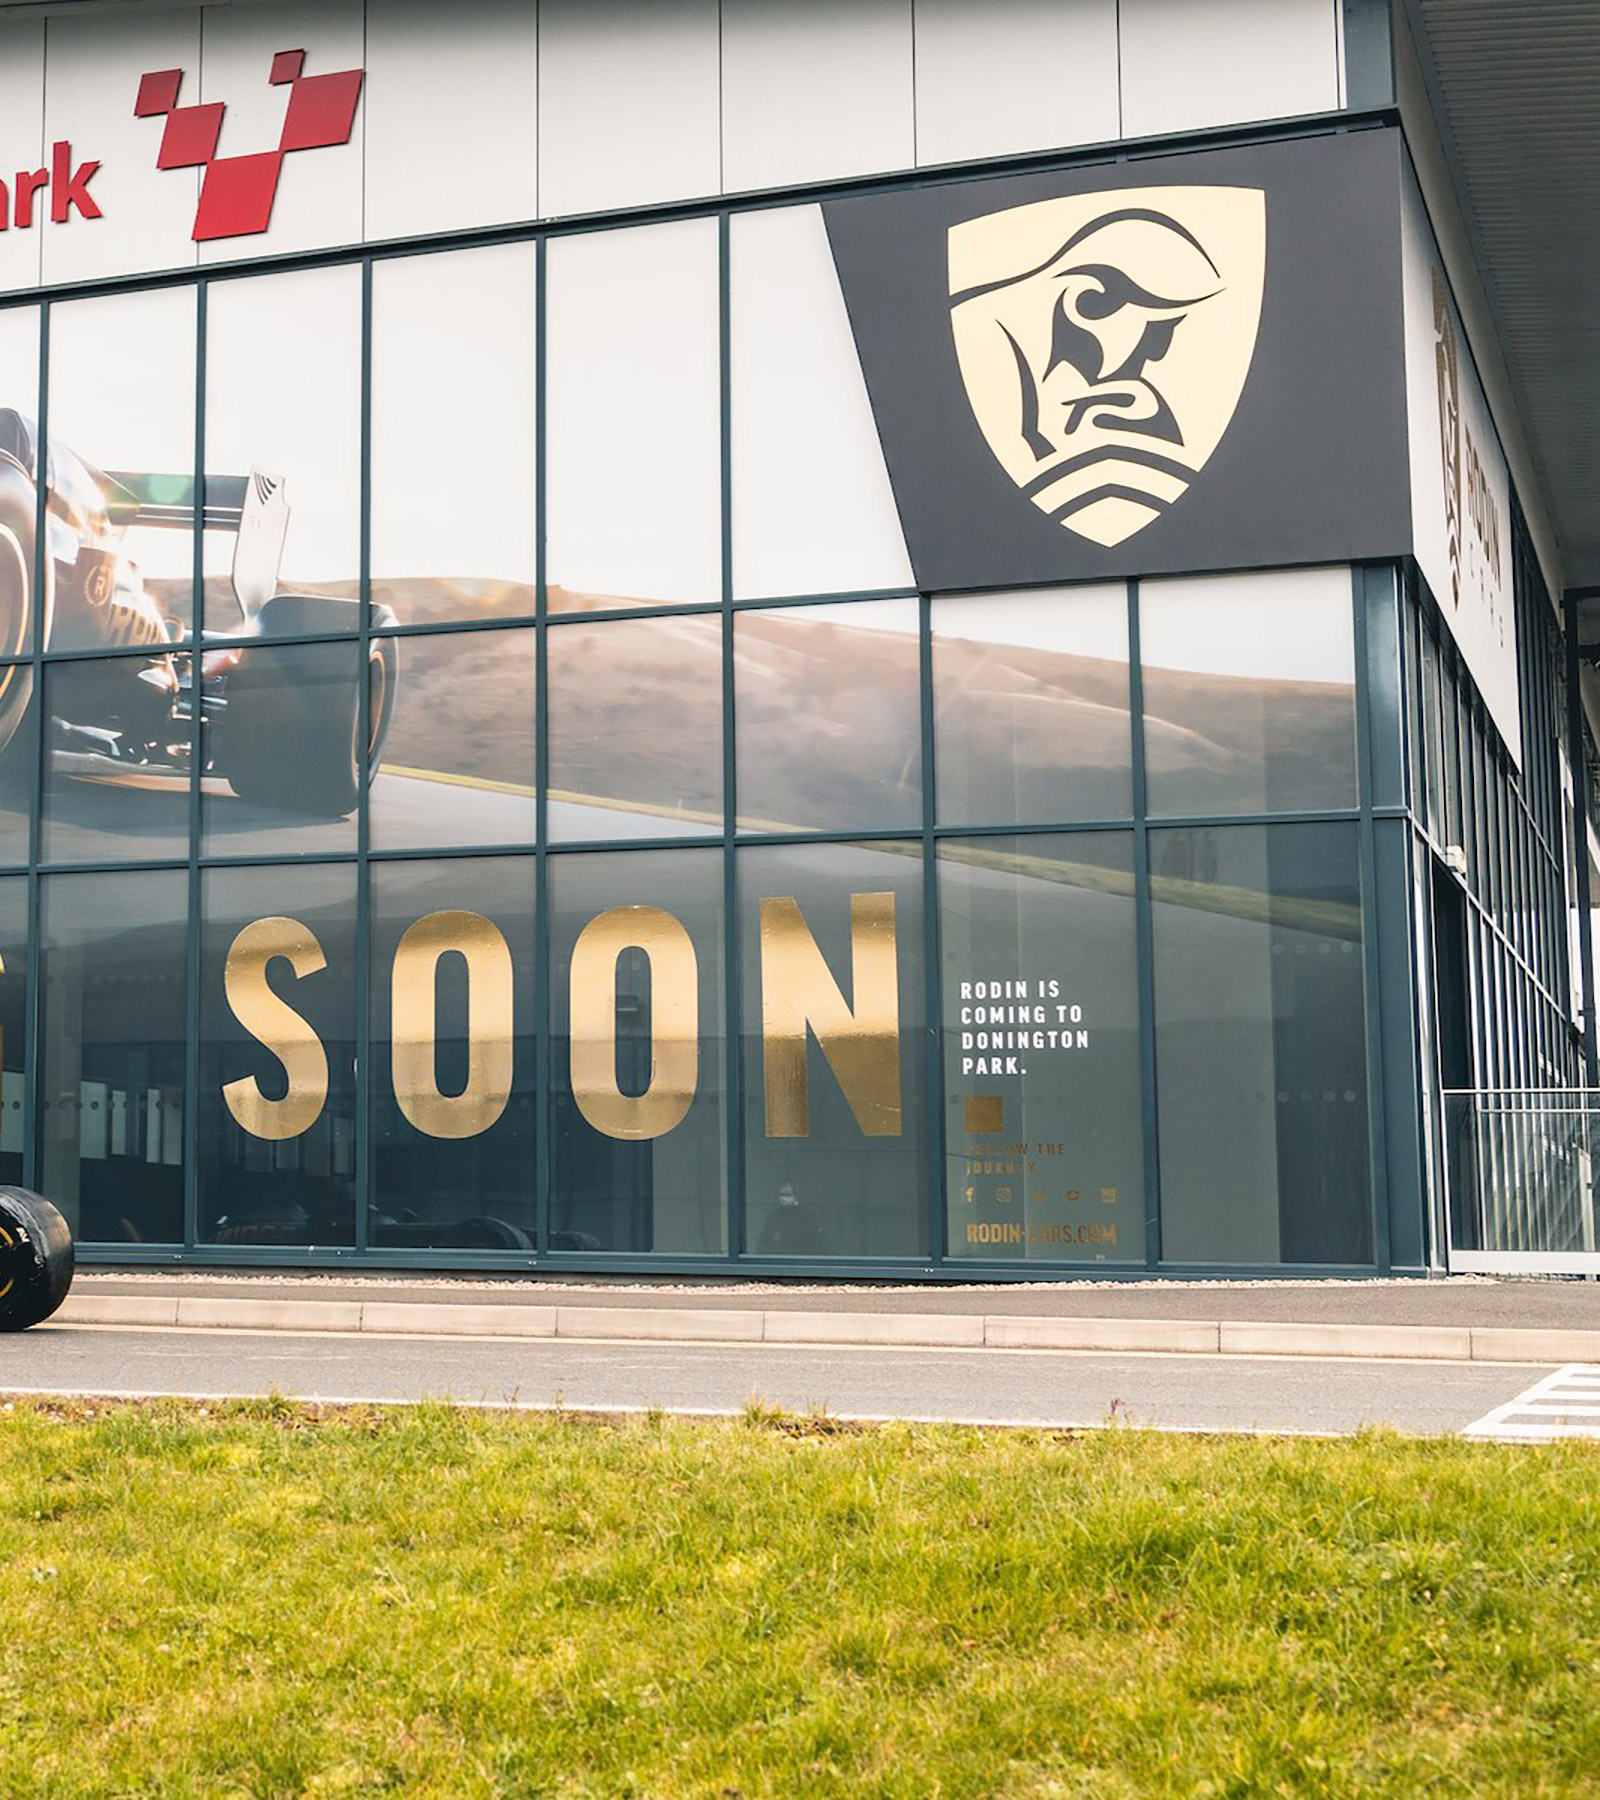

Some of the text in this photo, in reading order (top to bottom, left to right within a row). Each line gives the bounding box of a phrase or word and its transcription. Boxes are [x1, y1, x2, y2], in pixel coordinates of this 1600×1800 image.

[961, 980, 1060, 999] RODIN IS
[222, 892, 902, 1141] SOON
[961, 1005, 1082, 1024] COMING TO
[962, 1030, 1089, 1050] DONINGTON
[962, 1057, 1027, 1075] PARK.
[1037, 1143, 1064, 1155] THE
